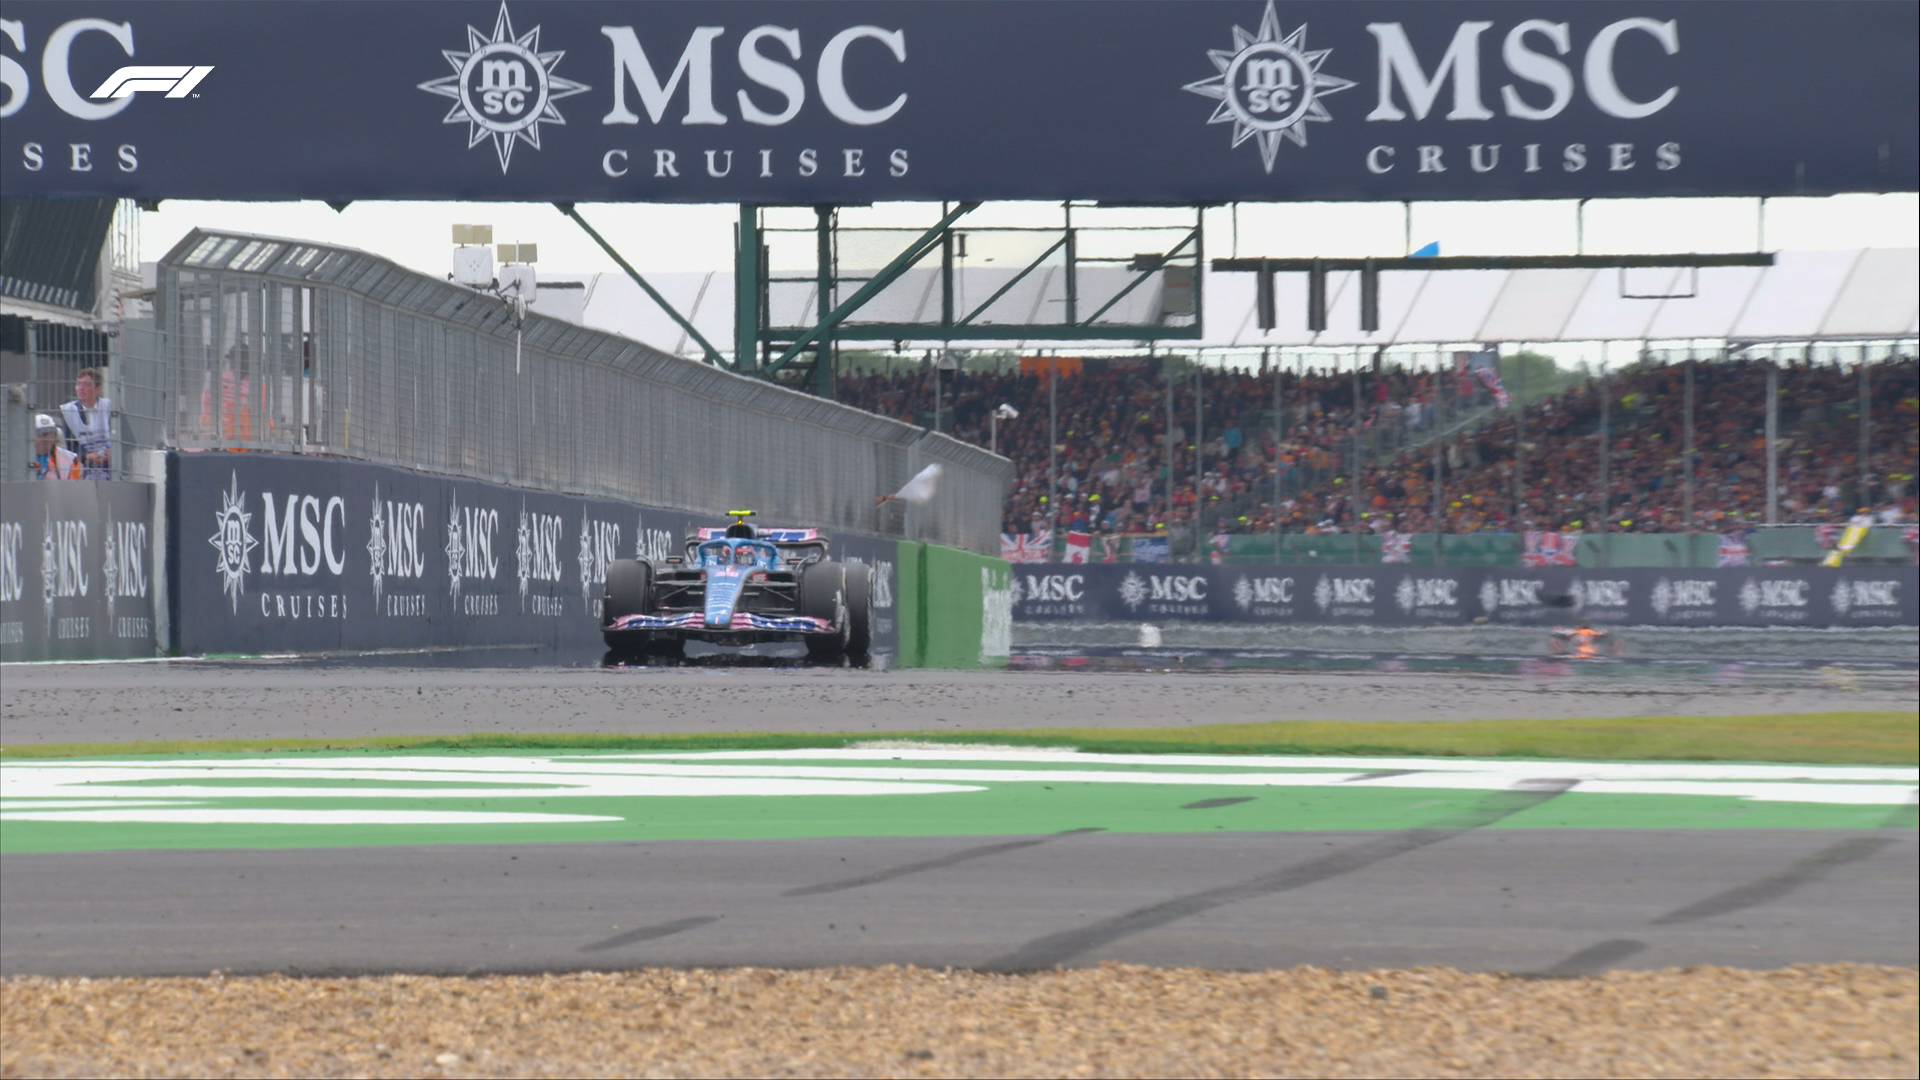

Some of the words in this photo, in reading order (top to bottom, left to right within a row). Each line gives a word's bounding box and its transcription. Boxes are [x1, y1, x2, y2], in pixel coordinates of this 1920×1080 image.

[601, 25, 908, 126] MSC
[1366, 17, 1680, 120] MSC
[603, 149, 909, 178] CRUISES
[1366, 142, 1682, 175] CRUISES
[0, 522, 23, 601] SC
[57, 520, 88, 597] MSC
[118, 521, 147, 597] MSC
[261, 492, 345, 575] MSC
[387, 501, 424, 578] MSC
[465, 507, 498, 579] MSC
[532, 513, 562, 582] MSC
[261, 593, 347, 619] CRUISES
[387, 595, 425, 616] CRUISES
[465, 595, 498, 615] CRUISES
[1027, 575, 1084, 601] MSC
[1150, 575, 1208, 601] MSC
